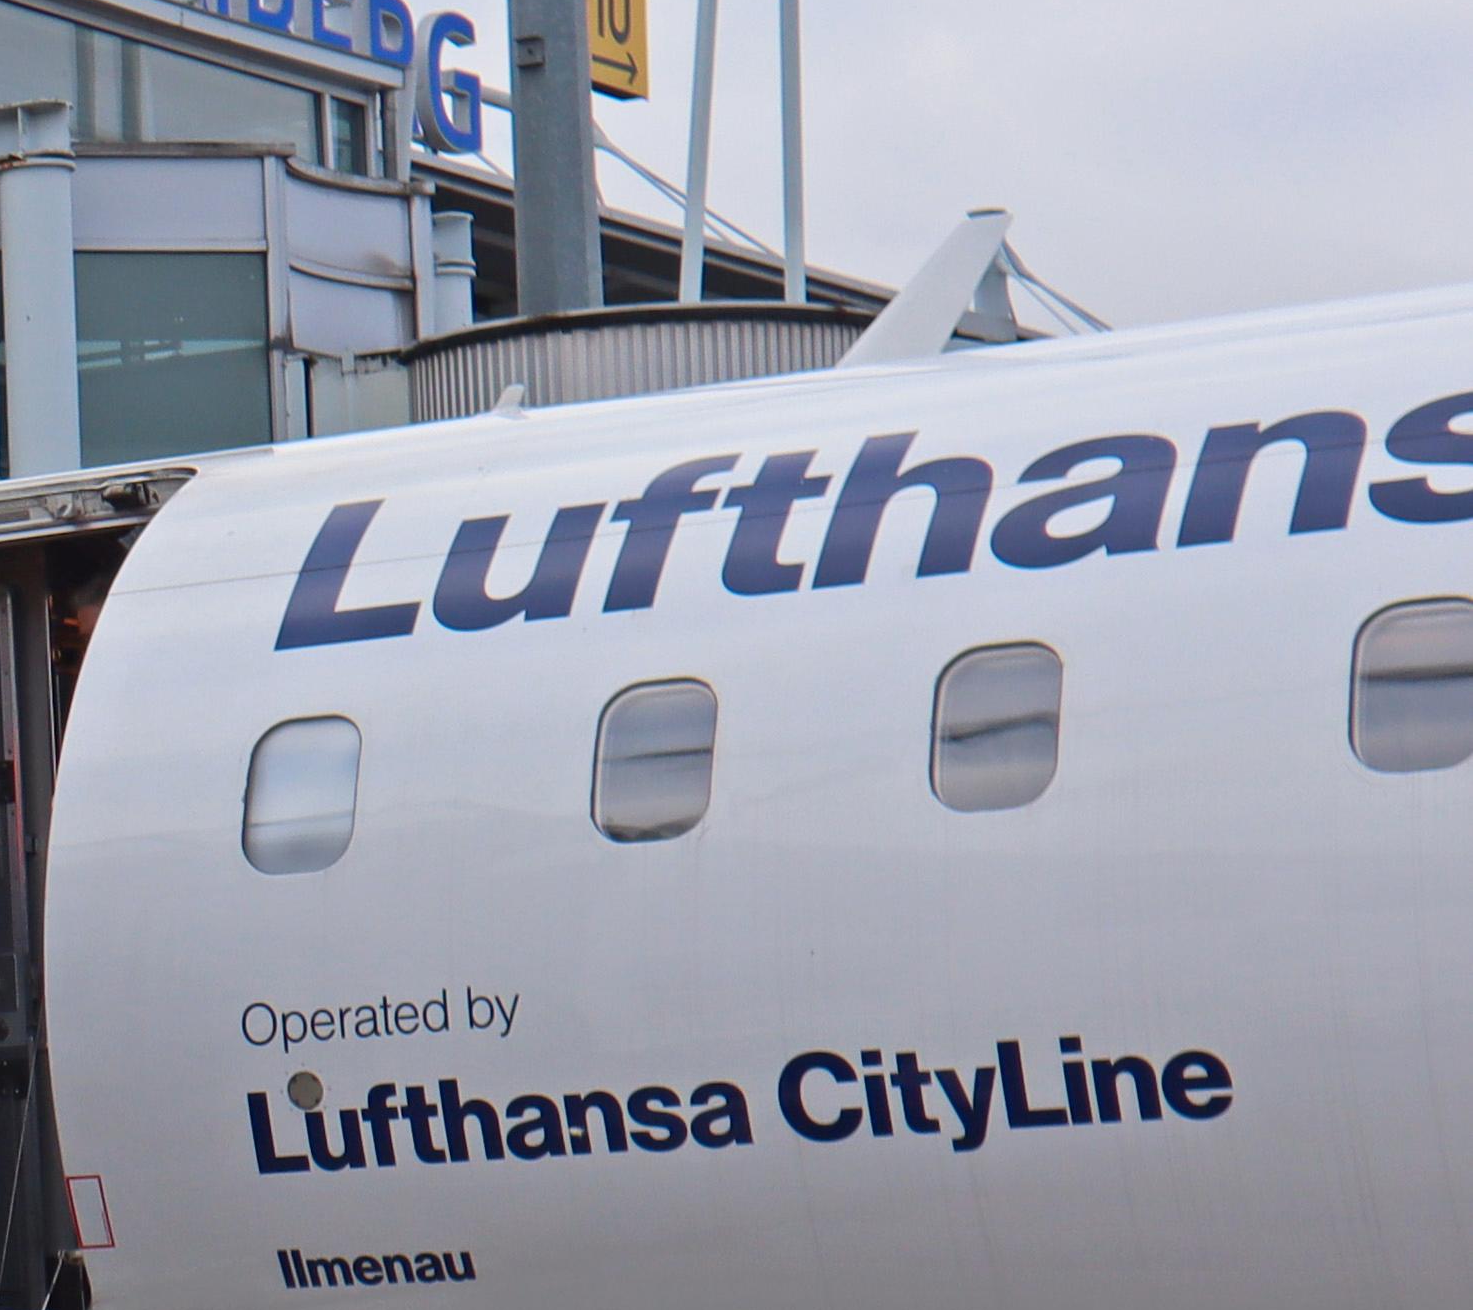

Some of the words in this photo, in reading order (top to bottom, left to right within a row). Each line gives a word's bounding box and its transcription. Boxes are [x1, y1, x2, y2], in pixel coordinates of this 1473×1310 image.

[241, 988, 450, 1054] Operated
[467, 986, 520, 1039] by
[247, 1077, 753, 1175] Lufthansa
[778, 1035, 1235, 1153] CityLine
[276, 1248, 477, 1289] Ilmenau
